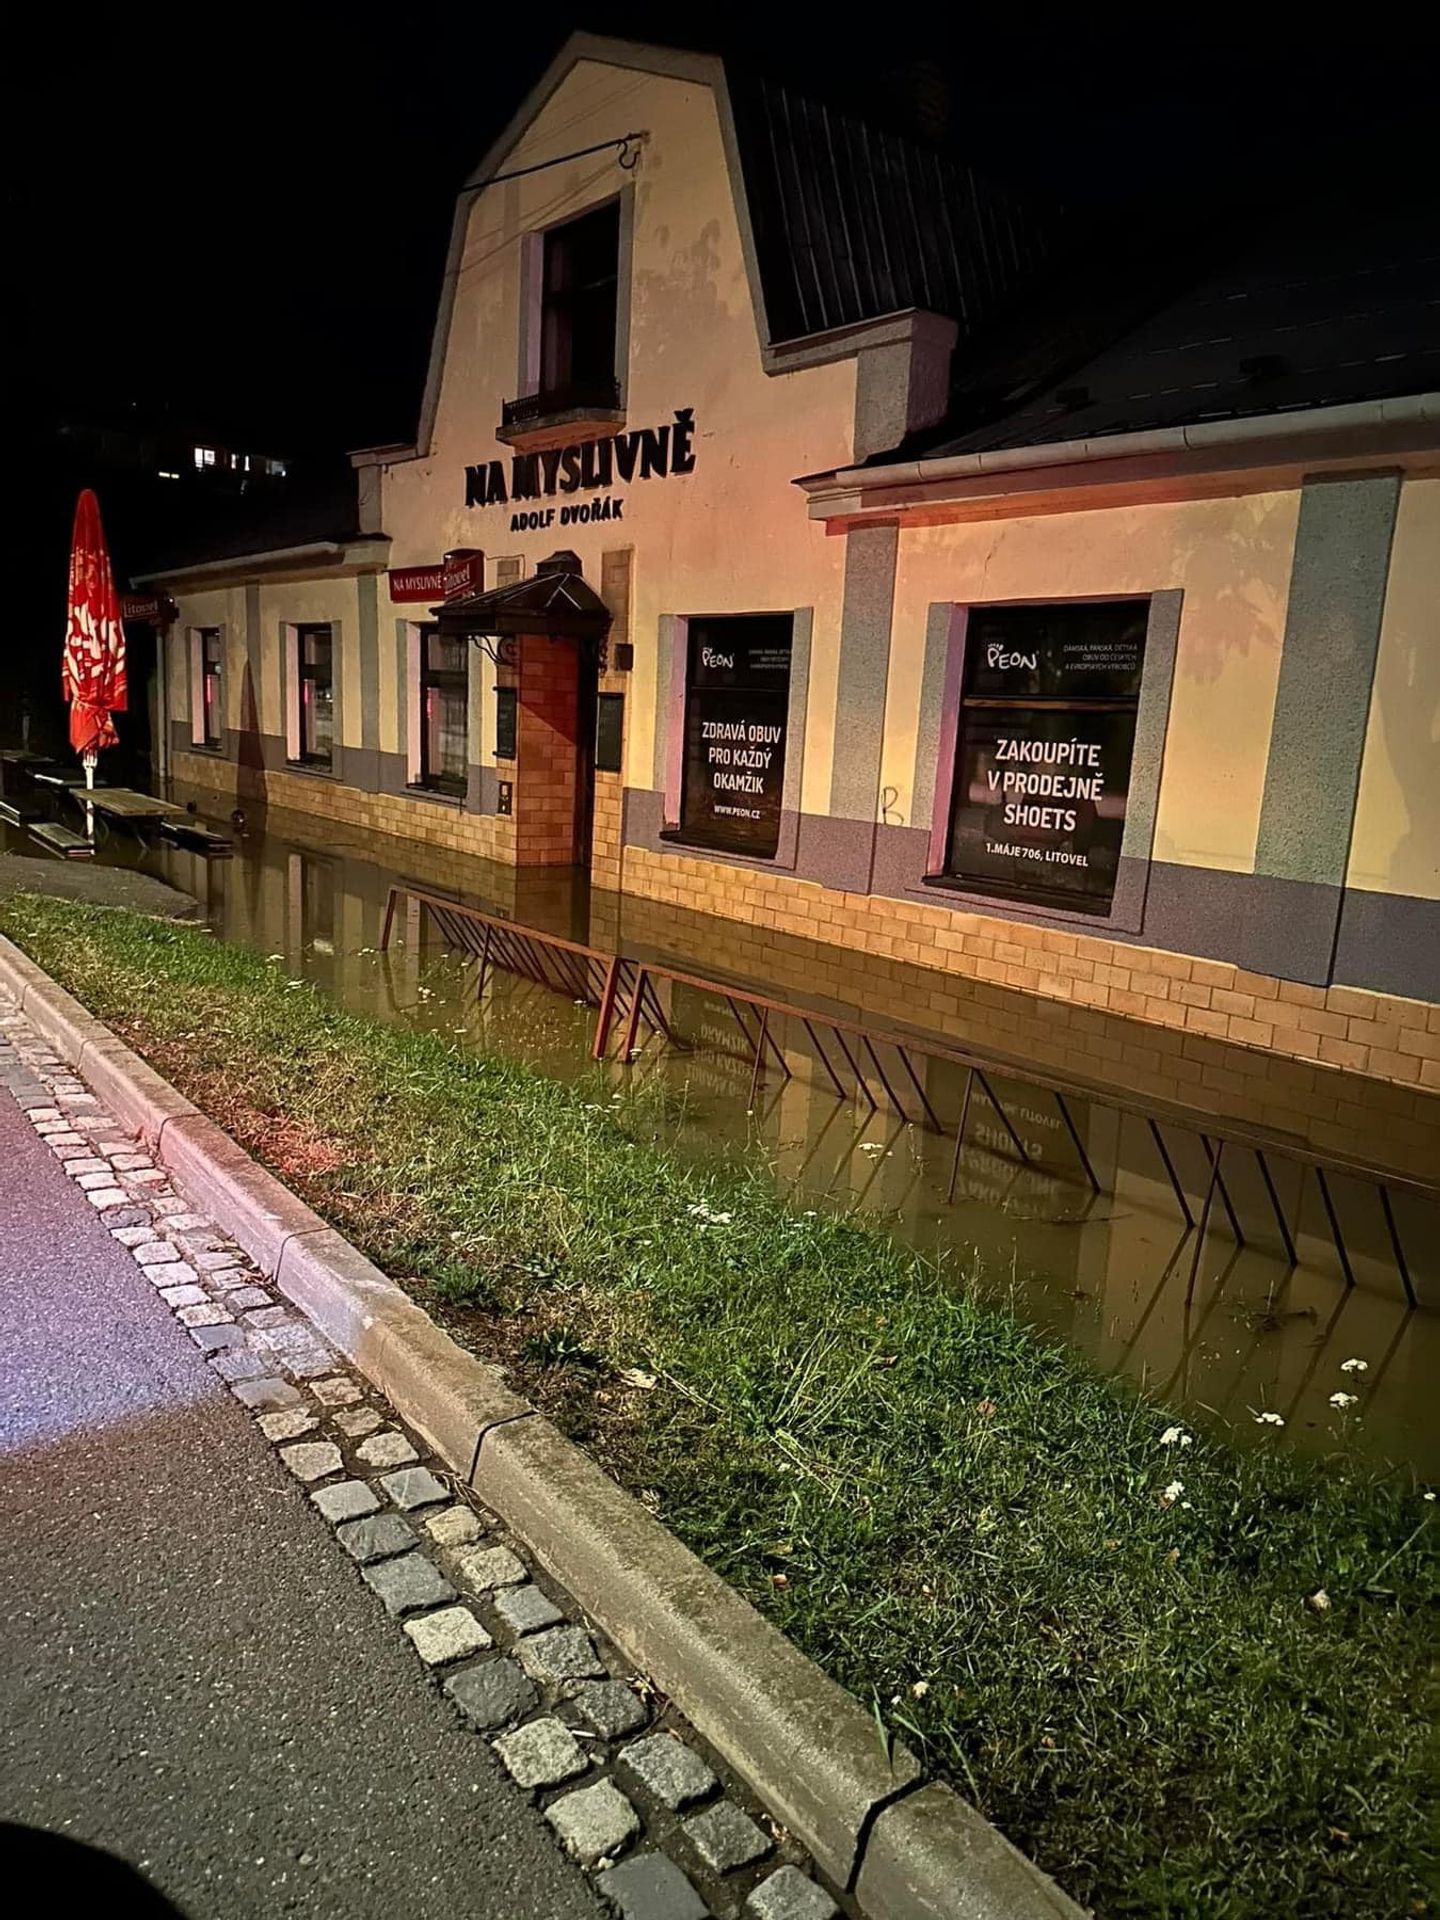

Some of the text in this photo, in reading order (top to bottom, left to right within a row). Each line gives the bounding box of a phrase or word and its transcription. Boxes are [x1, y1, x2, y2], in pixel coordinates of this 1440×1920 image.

[464, 408, 697, 508] NA MYSLIVNĚ
[510, 496, 624, 531] ADOLF DVOŘÁK
[393, 572, 442, 591] NA MYSLIVNĚ
[702, 647, 734, 668] PEON
[987, 645, 1037, 670] PEON
[702, 720, 781, 743] ZDRAVÁ OBUV
[708, 746, 772, 769] PRO KAŽDÝ
[995, 737, 1102, 767] ZAKOUPÍTE
[713, 771, 764, 794] OKAMŽIK
[987, 770, 1104, 801] V PRODEJNĚ
[714, 805, 760, 819] WWW.PEON.CZ
[1003, 803, 1077, 832] SHOETS
[1022, 848, 1043, 862] 706,
[1045, 851, 1089, 867] LITOVEL
